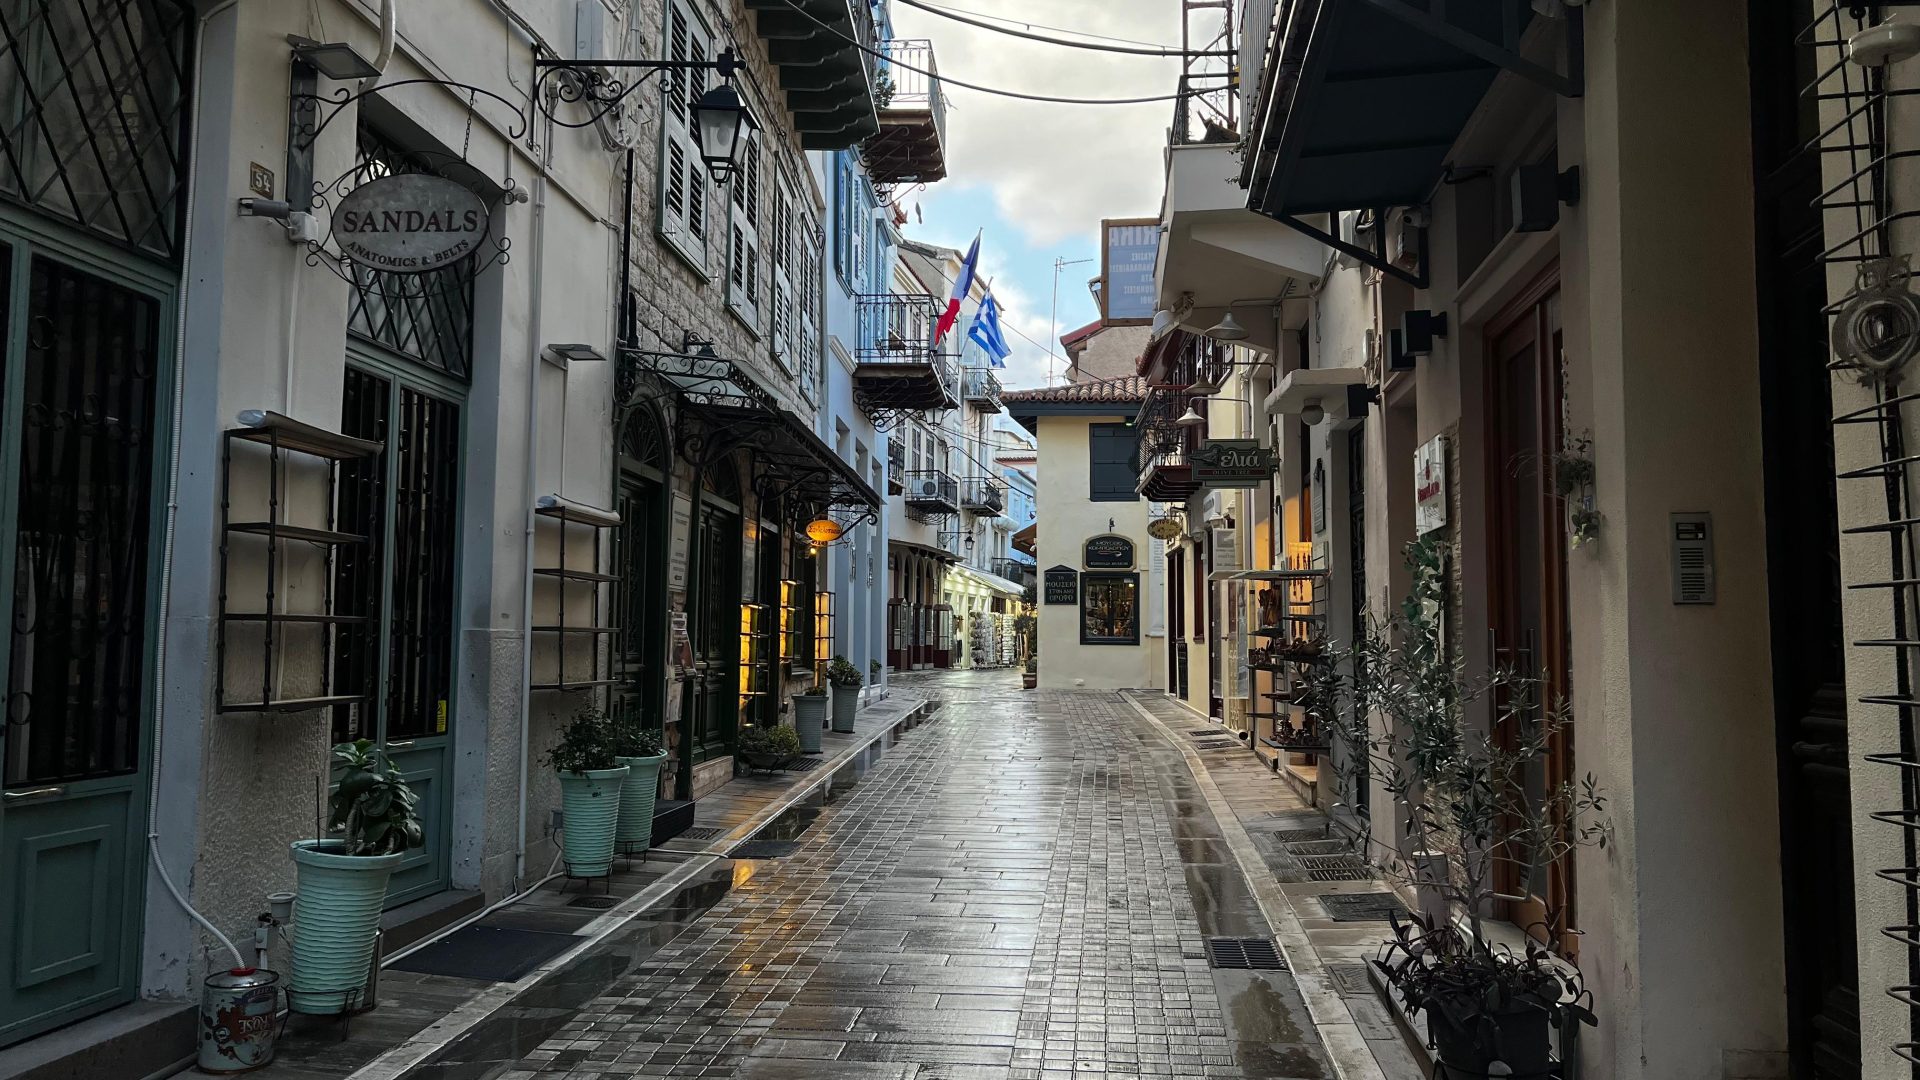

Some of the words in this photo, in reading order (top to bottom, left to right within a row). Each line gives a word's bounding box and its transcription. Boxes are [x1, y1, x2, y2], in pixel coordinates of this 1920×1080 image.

[255, 172, 271, 193] 54
[342, 210, 478, 233] SANDALS
[347, 241, 417, 267] ANATOMICS
[421, 256, 430, 266] &
[435, 239, 469, 262] BELTS
[1220, 450, 1261, 468] ελιά
